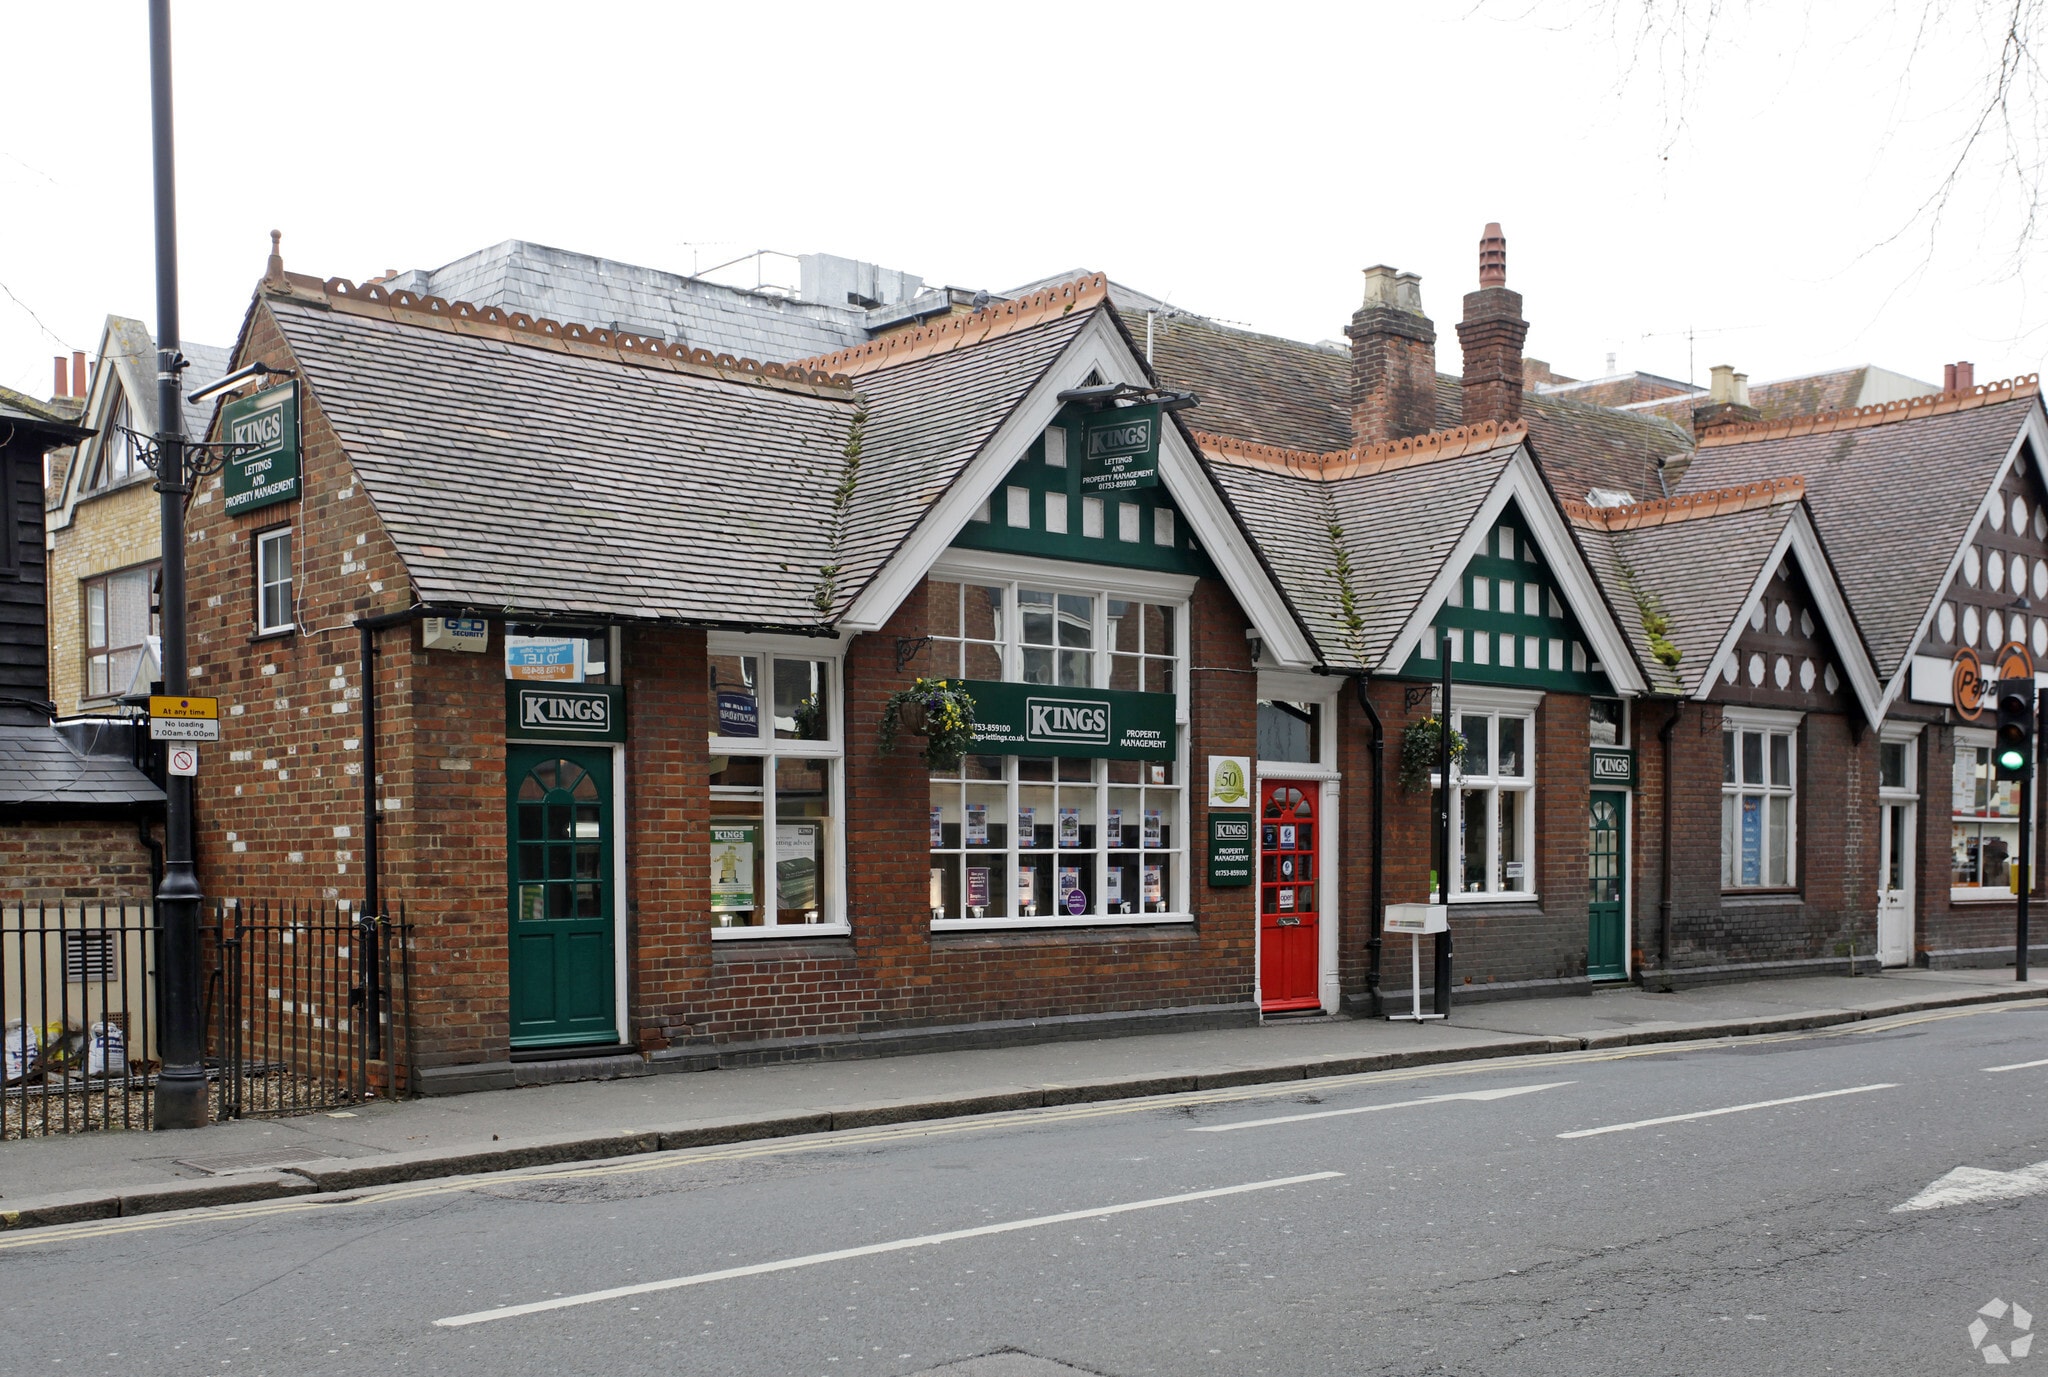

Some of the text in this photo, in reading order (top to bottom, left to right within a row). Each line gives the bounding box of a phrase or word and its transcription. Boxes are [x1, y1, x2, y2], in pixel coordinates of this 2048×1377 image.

[234, 413, 280, 457] KINGS
[1090, 425, 1147, 454] KINGS
[244, 458, 272, 476] LETTINGS
[1104, 456, 1133, 466] LETTINGS
[1111, 465, 1125, 473] AND
[252, 474, 266, 487] AND
[1082, 469, 1154, 484] PROPERTY MANAGEMENT
[1098, 480, 1137, 490] 01753-859100
[225, 478, 295, 508] PROPERTY MANAGEMENT
[444, 617, 485, 631] GCD
[452, 630, 485, 638] SECURITY
[1960, 671, 1999, 699] Papa
[524, 697, 606, 724] KINGS
[178, 721, 204, 729] loading
[1030, 705, 1107, 736] KINGS
[1126, 729, 1161, 739] PROPERTY
[1120, 739, 1167, 749] MANAGEMENT
[1595, 757, 1628, 774] KINGS
[1221, 772, 1237, 787] 50
[714, 831, 744, 840] KINGS
[1217, 824, 1247, 838] KINGS
[1281, 894, 1293, 903] open
